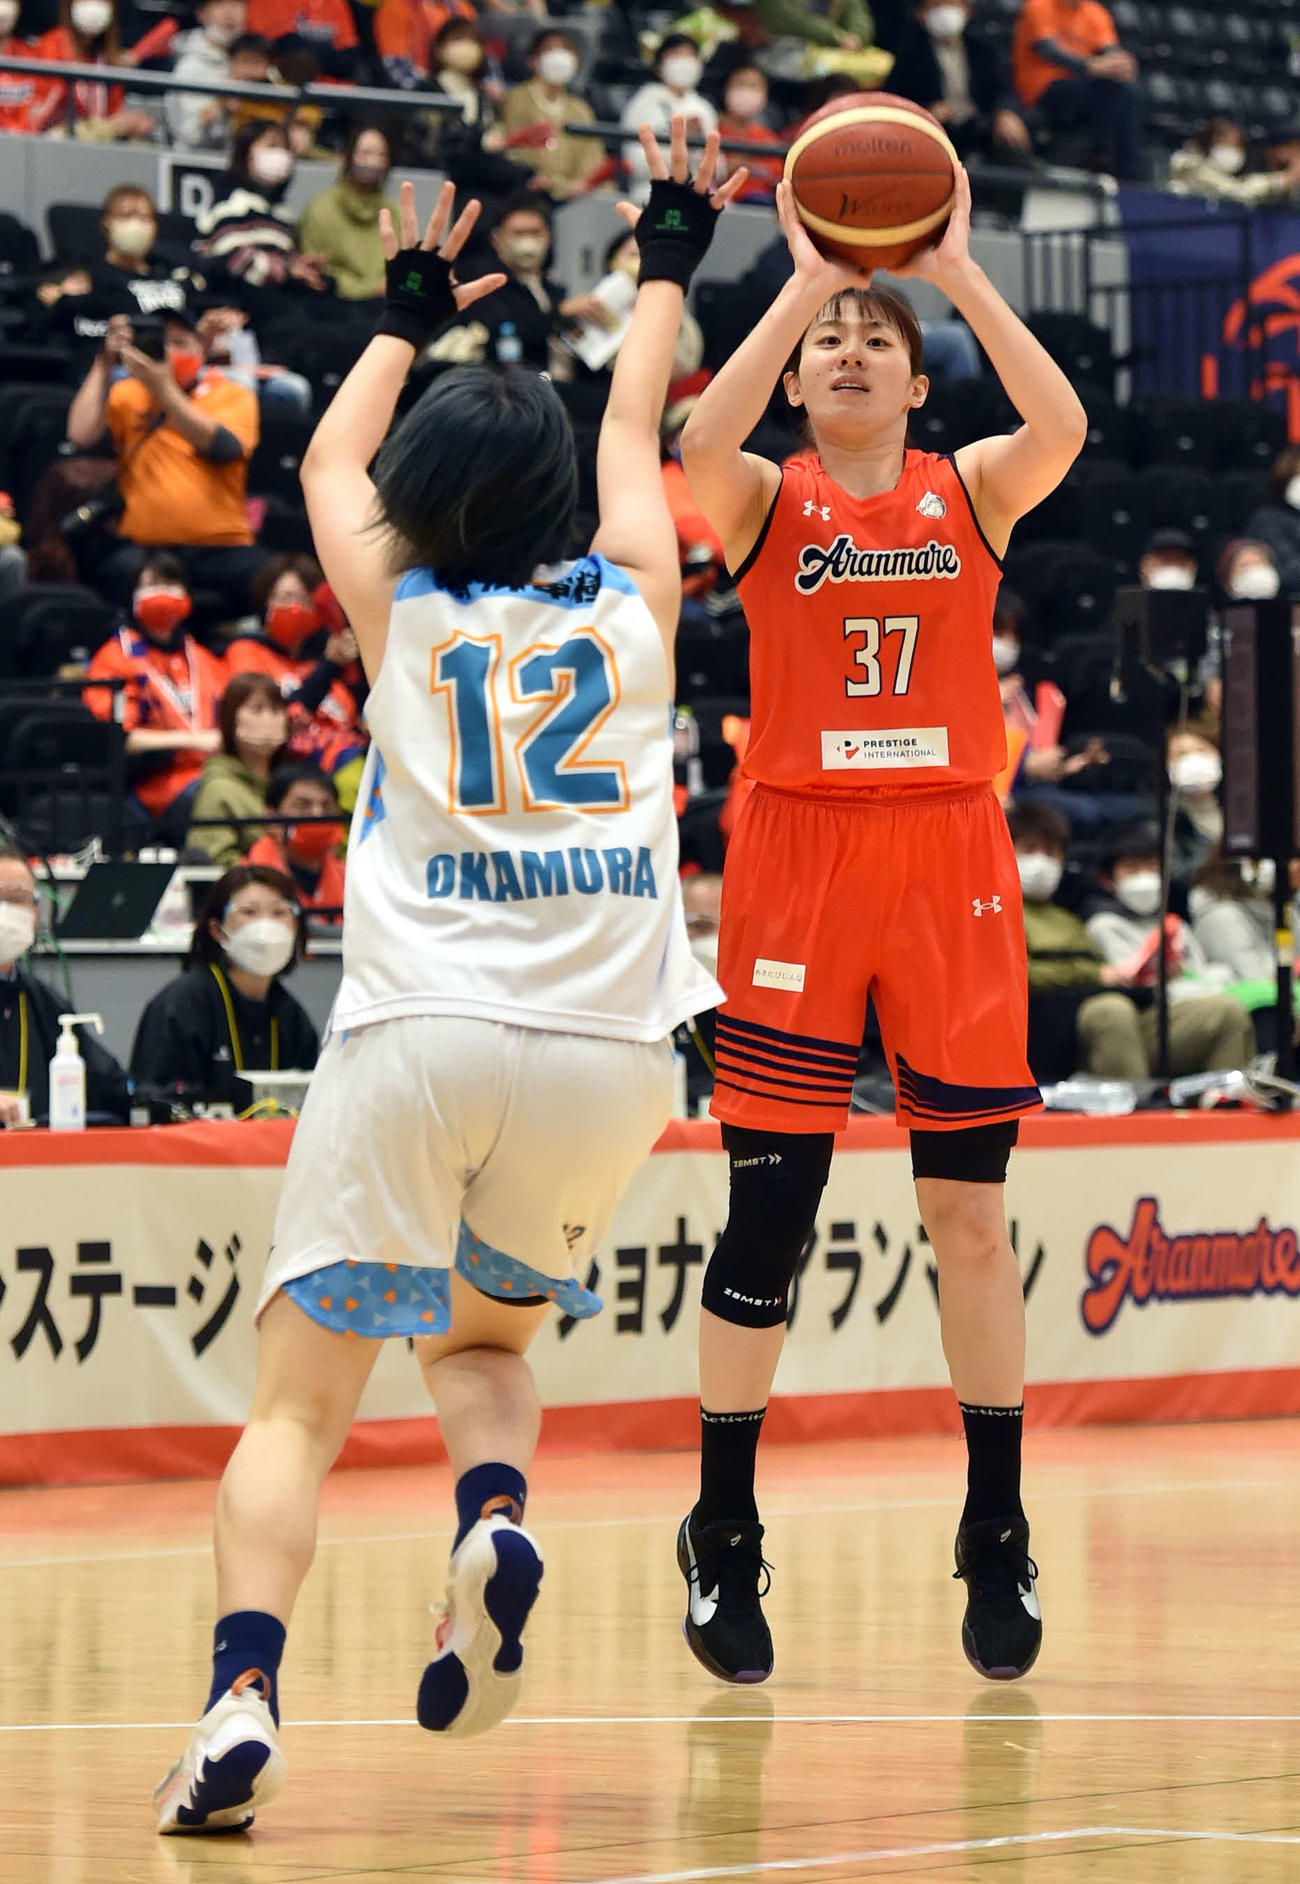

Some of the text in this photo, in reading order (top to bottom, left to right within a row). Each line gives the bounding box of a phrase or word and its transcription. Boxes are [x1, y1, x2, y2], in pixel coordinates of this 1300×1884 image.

[795, 534, 961, 595] Aranmare
[843, 615, 920, 698] 37
[430, 626, 630, 816] 12
[863, 738, 918, 748] PRESTIGE
[863, 748, 937, 760] INTERNATIONAL
[426, 846, 658, 903] OKAMURA
[0, 1233, 241, 1366] ステージ
[1079, 1195, 1300, 1337] Aranmare
